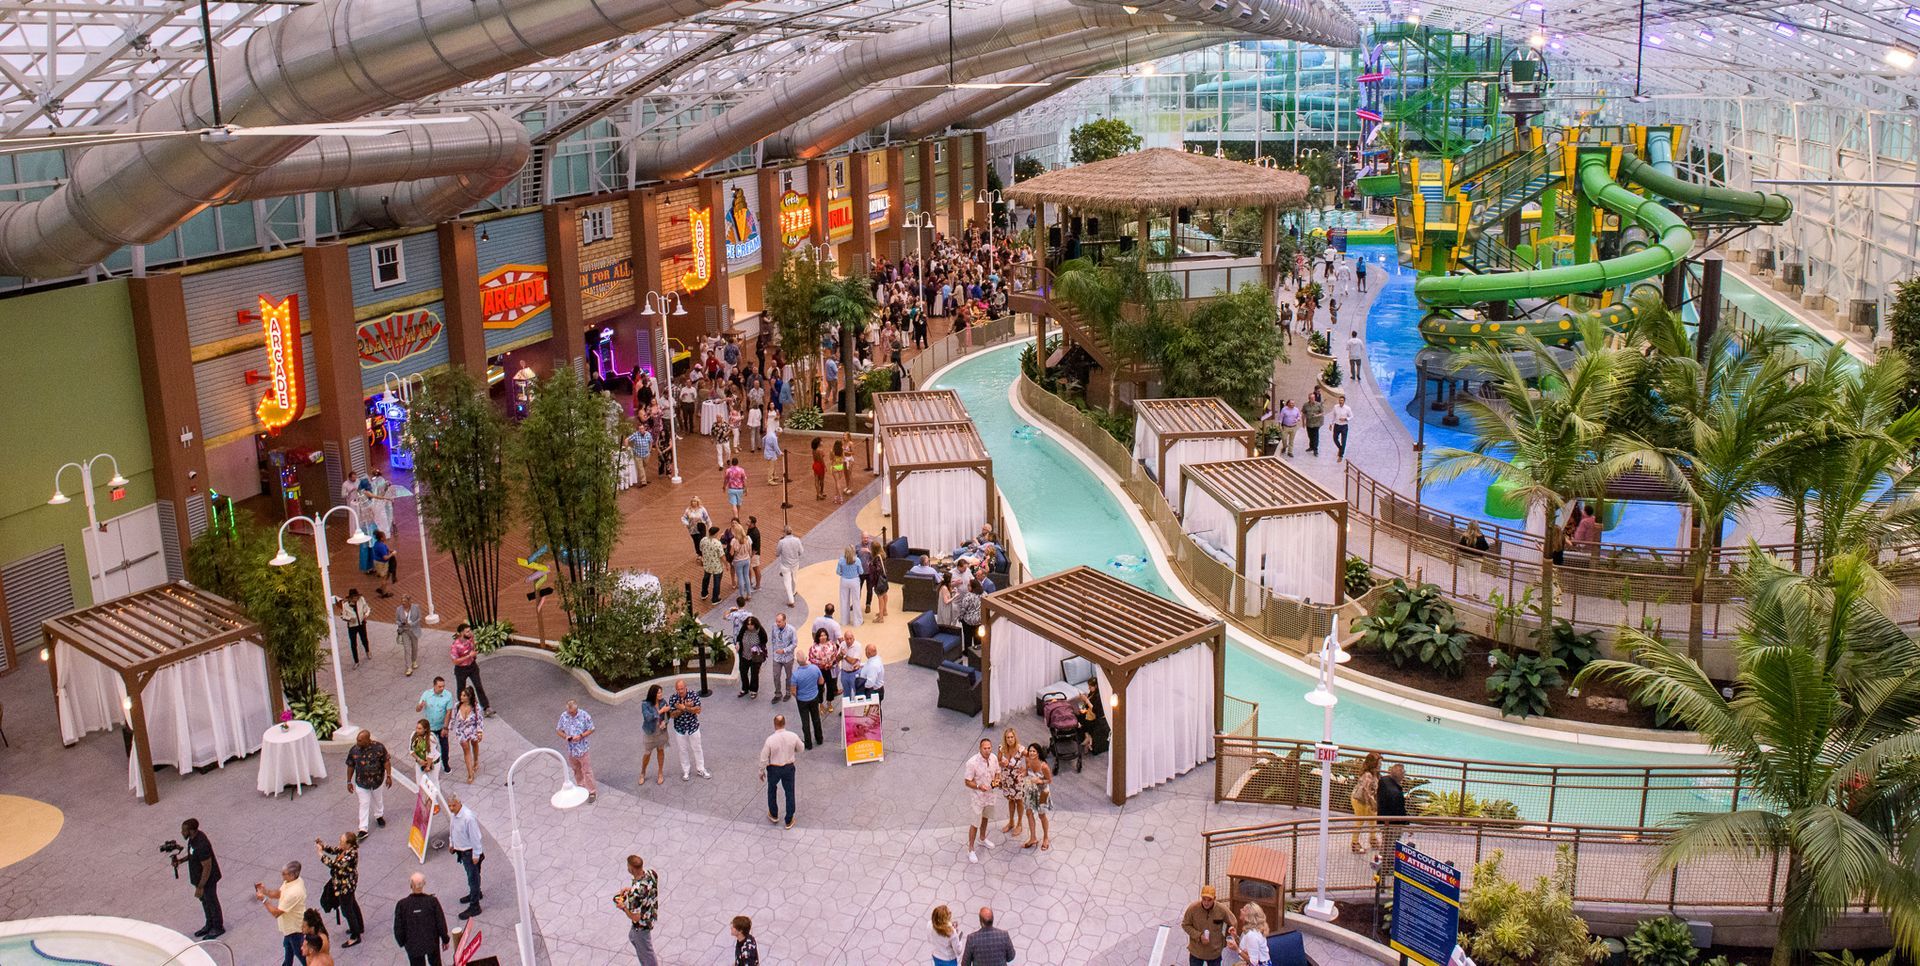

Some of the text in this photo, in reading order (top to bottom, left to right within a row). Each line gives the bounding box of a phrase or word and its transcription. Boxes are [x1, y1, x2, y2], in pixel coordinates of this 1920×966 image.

[828, 206, 852, 229] RILL
[695, 220, 706, 278] ARCADE
[726, 235, 761, 258] CE CREAM
[592, 269, 610, 284] FOR
[614, 260, 631, 279] ALL
[483, 278, 545, 317] ARCADE
[270, 318, 288, 409] ARCADE
[1433, 716, 1441, 725] FT
[1318, 748, 1336, 760] EXIT
[1402, 846, 1416, 857] KIDS
[1417, 853, 1437, 867] COVE
[1436, 863, 1455, 876] AREA
[1407, 857, 1447, 880] ATTENTION
